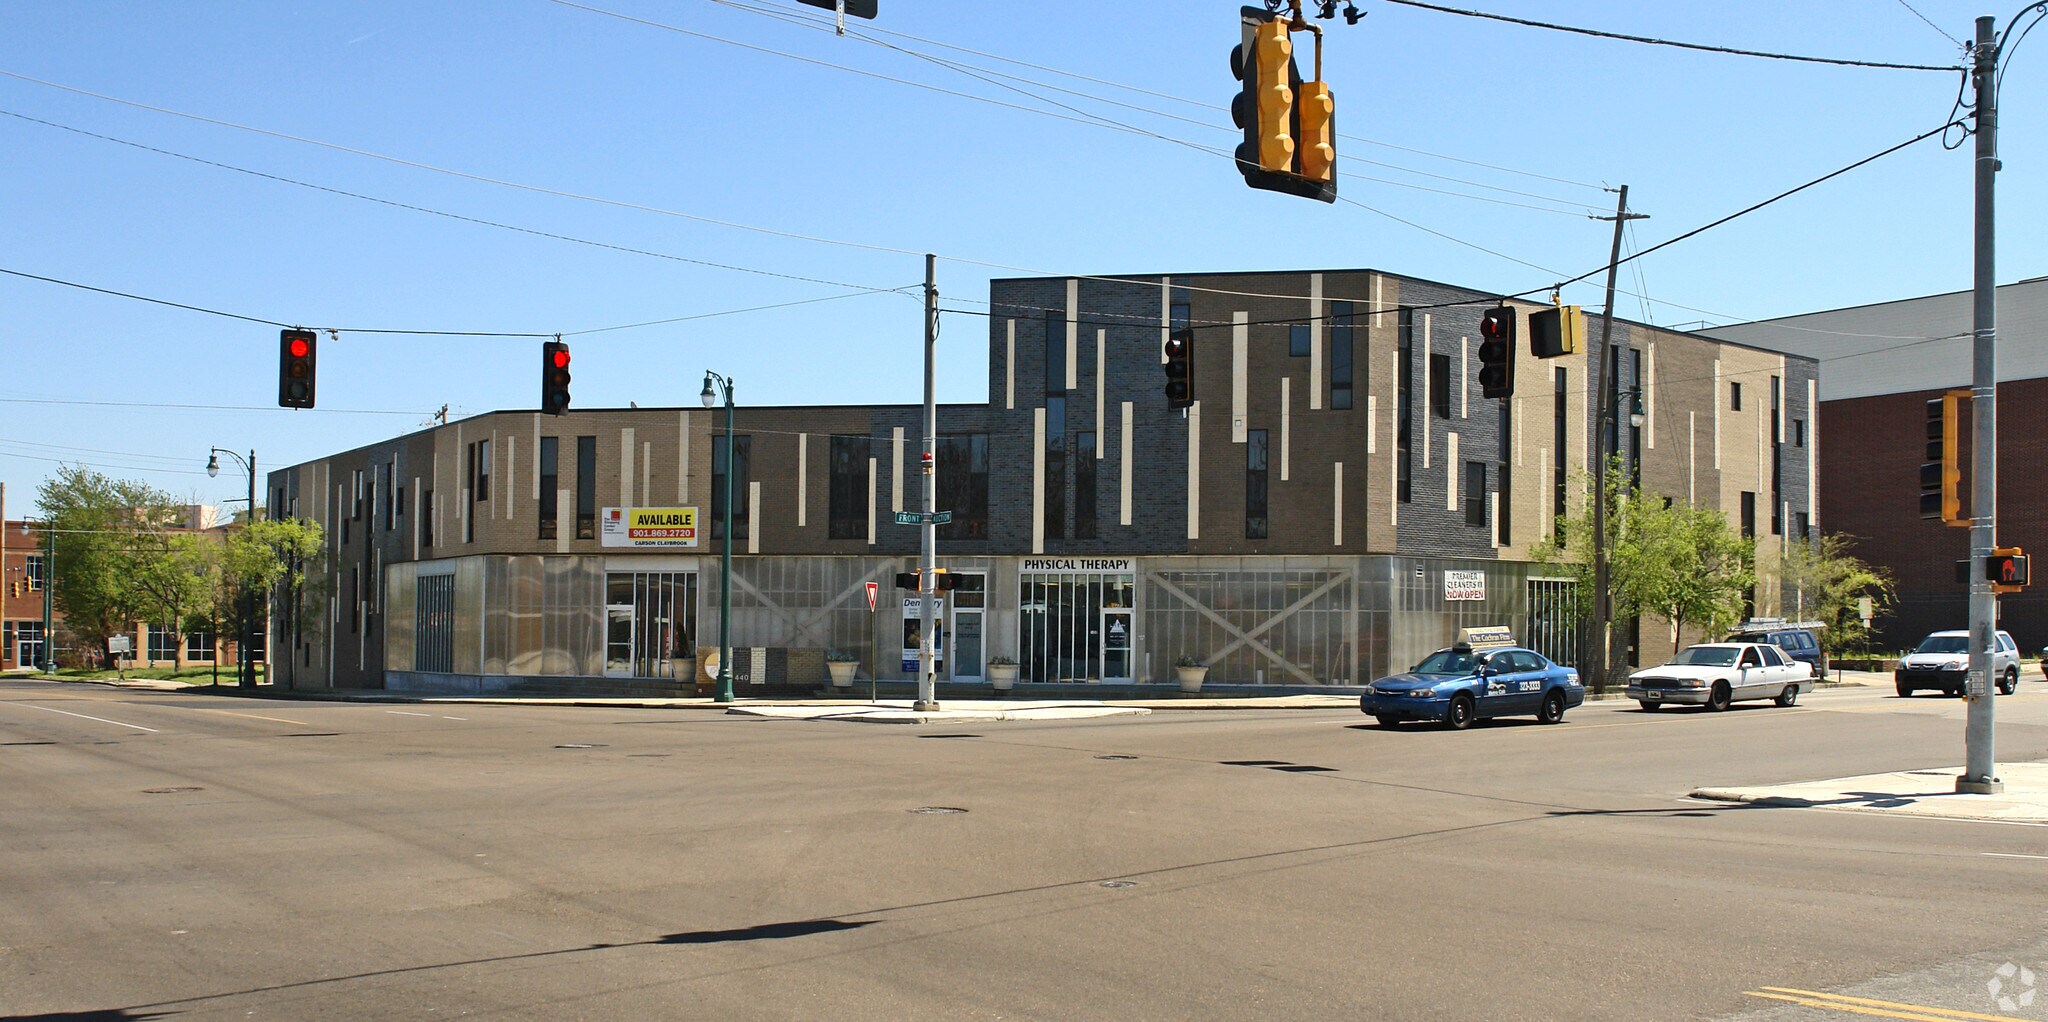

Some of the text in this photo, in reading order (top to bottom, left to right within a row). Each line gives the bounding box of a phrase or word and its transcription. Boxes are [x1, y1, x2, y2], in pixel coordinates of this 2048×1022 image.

[638, 515, 691, 525] AVAILABLE
[898, 514, 920, 523] FRONT
[633, 529, 691, 537] 901.869.2720
[1024, 560, 1129, 569] PHYSICAL THERAPY
[1447, 591, 1483, 599] NOW OPEN
[904, 599, 942, 608] Denry
[1519, 680, 1541, 691] 323-3333
